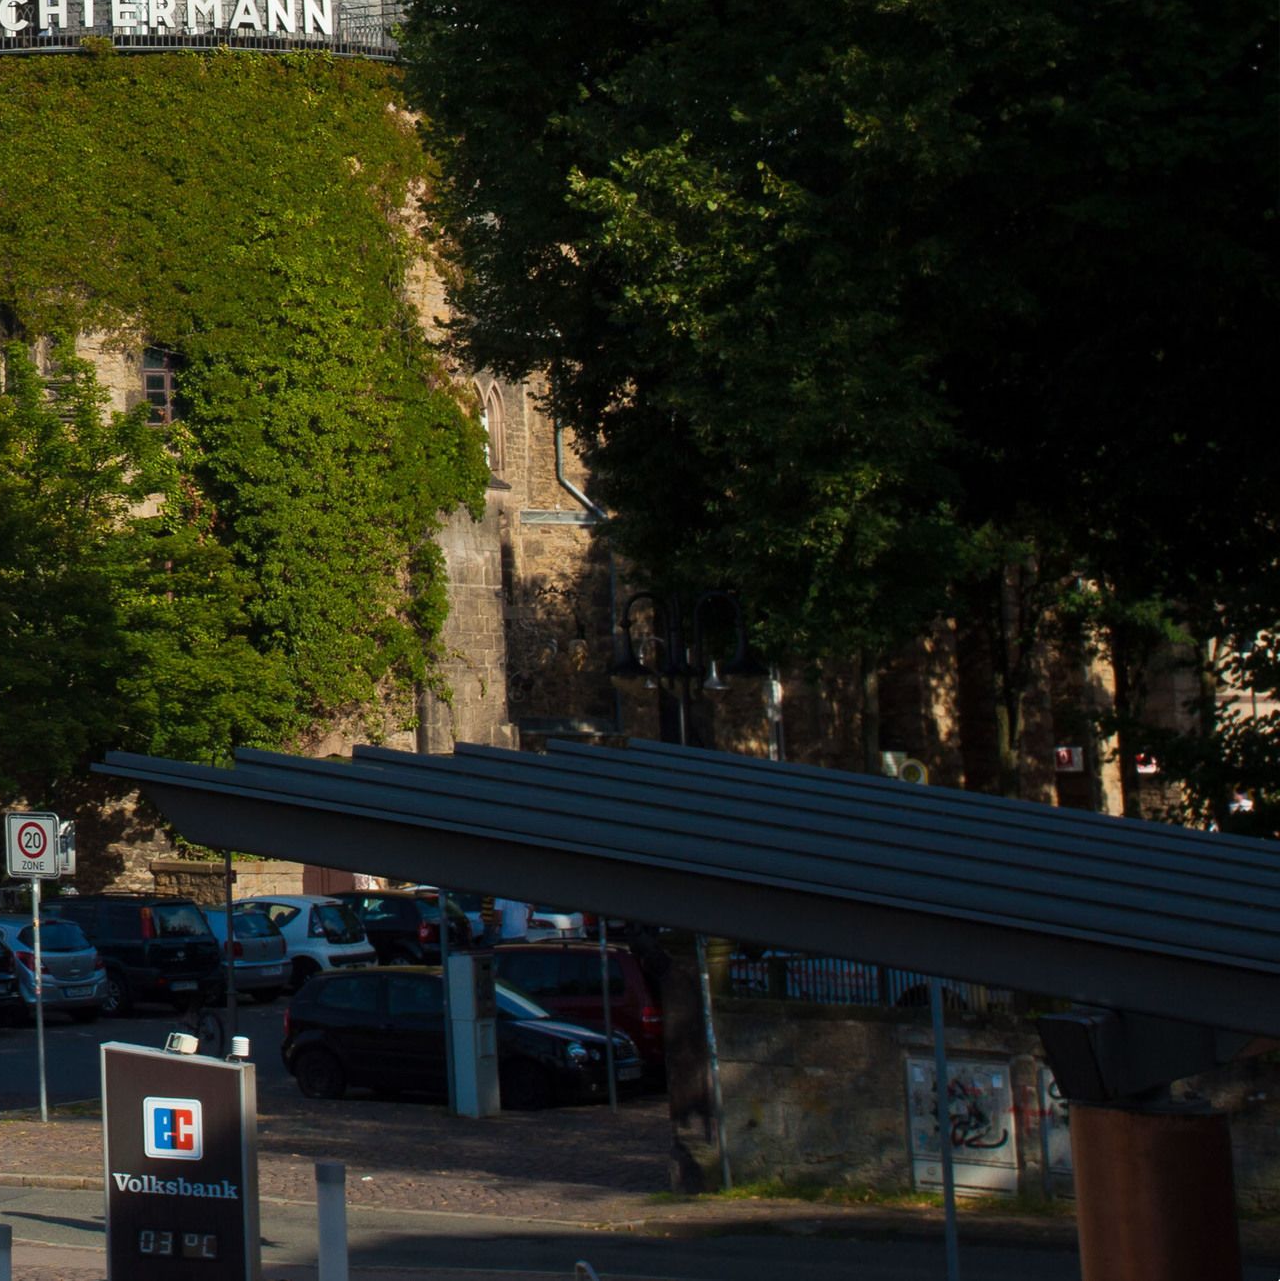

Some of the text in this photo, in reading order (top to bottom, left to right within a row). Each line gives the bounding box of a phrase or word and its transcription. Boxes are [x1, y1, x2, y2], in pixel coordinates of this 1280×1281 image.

[24, 831, 41, 849] 20
[21, 860, 45, 871] ZONE
[112, 1172, 239, 1199] Volksbank
